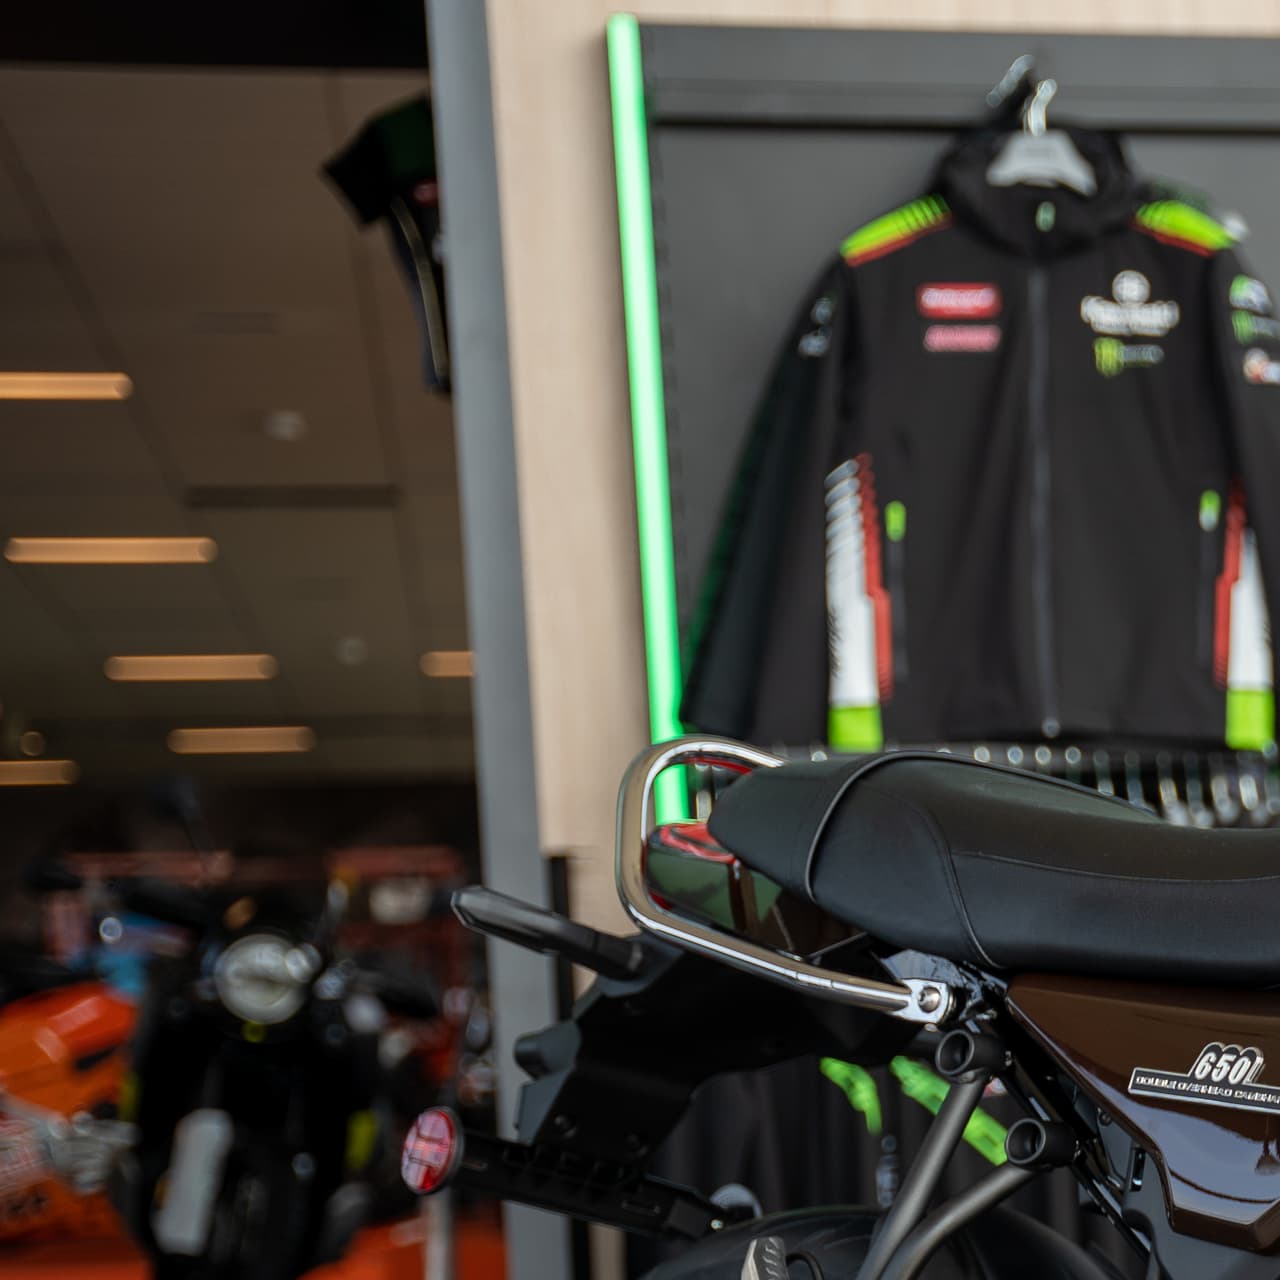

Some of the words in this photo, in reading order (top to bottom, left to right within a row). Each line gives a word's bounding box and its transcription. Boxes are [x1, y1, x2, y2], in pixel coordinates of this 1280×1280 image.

[1194, 1051, 1253, 1085] 650
[1135, 1075, 1176, 1090] DOUBLE
[1177, 1081, 1233, 1098] OVERHEAD
